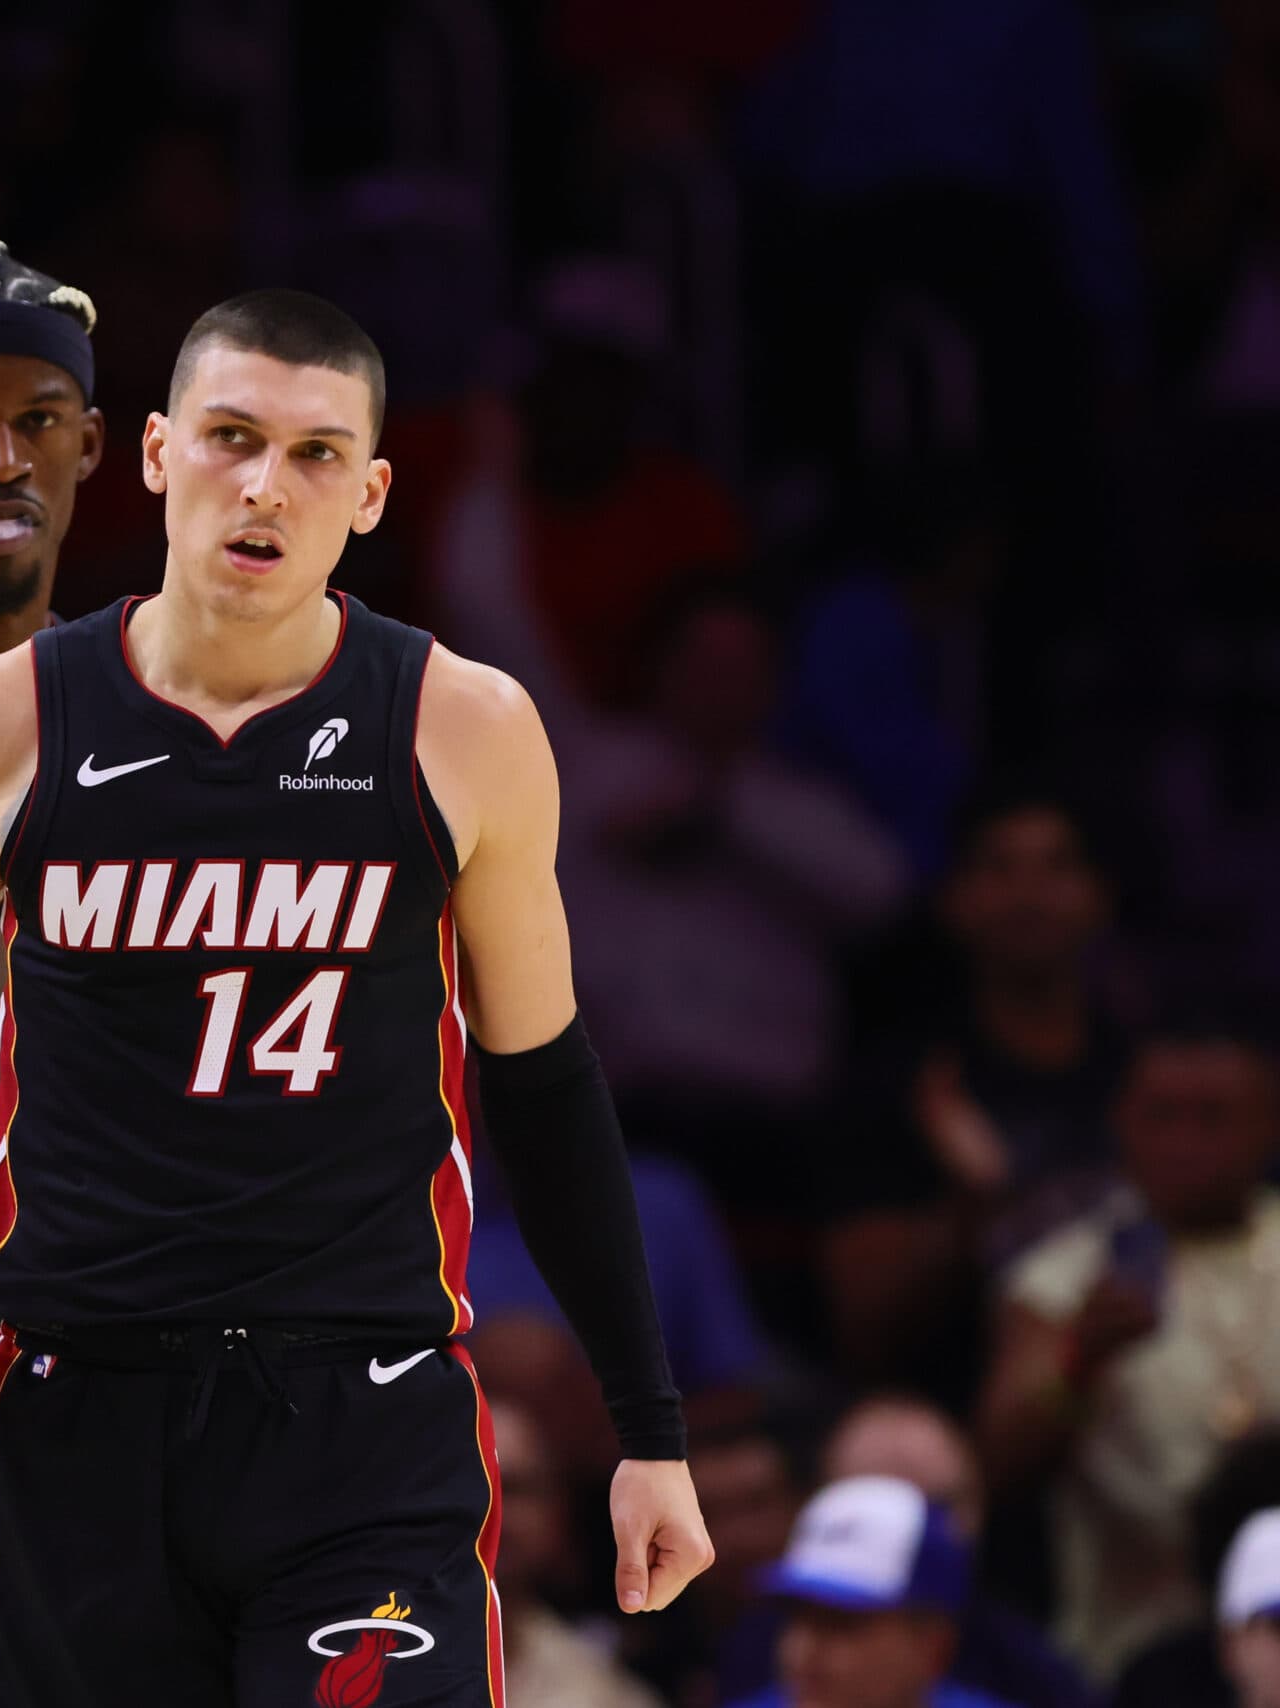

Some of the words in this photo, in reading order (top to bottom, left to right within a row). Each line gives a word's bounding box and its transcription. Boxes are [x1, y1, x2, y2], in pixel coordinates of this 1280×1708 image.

[279, 773, 373, 791] Robinhood
[39, 858, 398, 952] MIAMI
[185, 965, 352, 1097] 14
